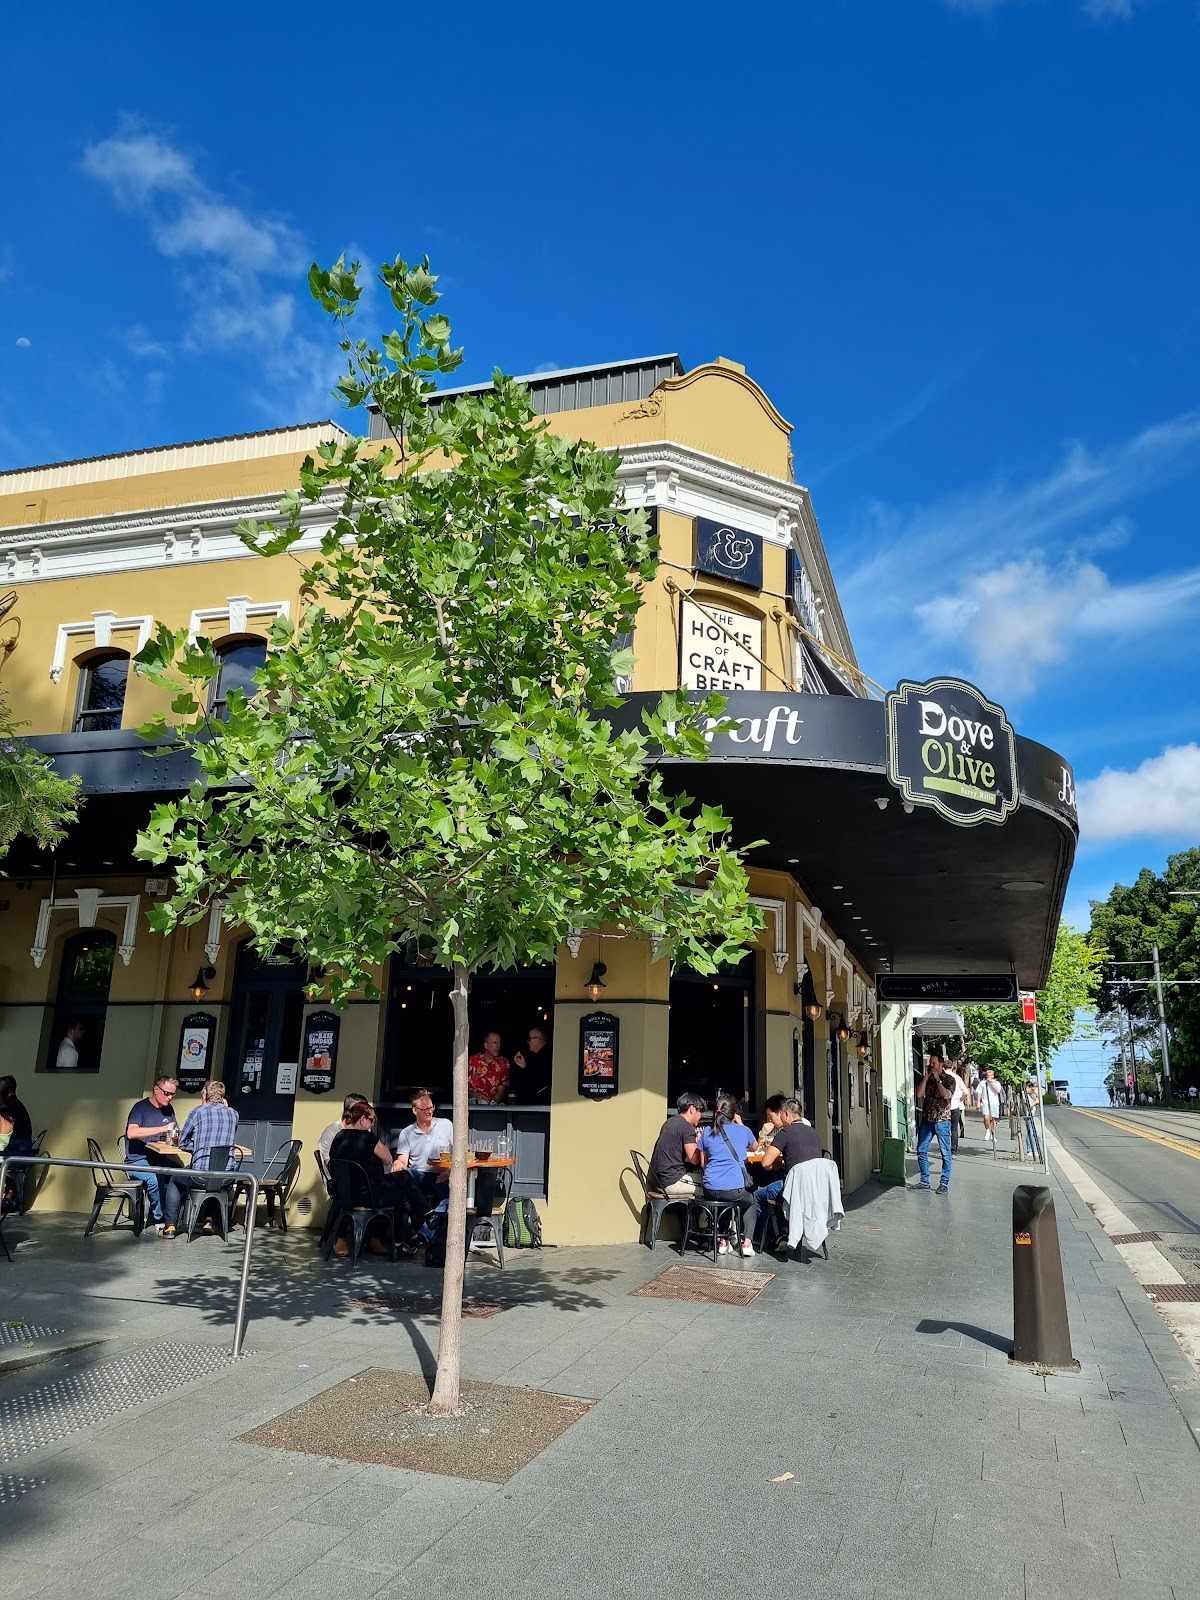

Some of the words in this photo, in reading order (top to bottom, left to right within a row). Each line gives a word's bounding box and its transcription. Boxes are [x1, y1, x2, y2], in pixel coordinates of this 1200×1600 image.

[712, 612, 734, 626] THE
[691, 620, 752, 651] HOME
[714, 646, 730, 657] OF
[689, 652, 754, 681] CRAFT
[918, 700, 995, 750] Dove
[960, 740, 973, 756] &
[921, 738, 996, 789] Olive
